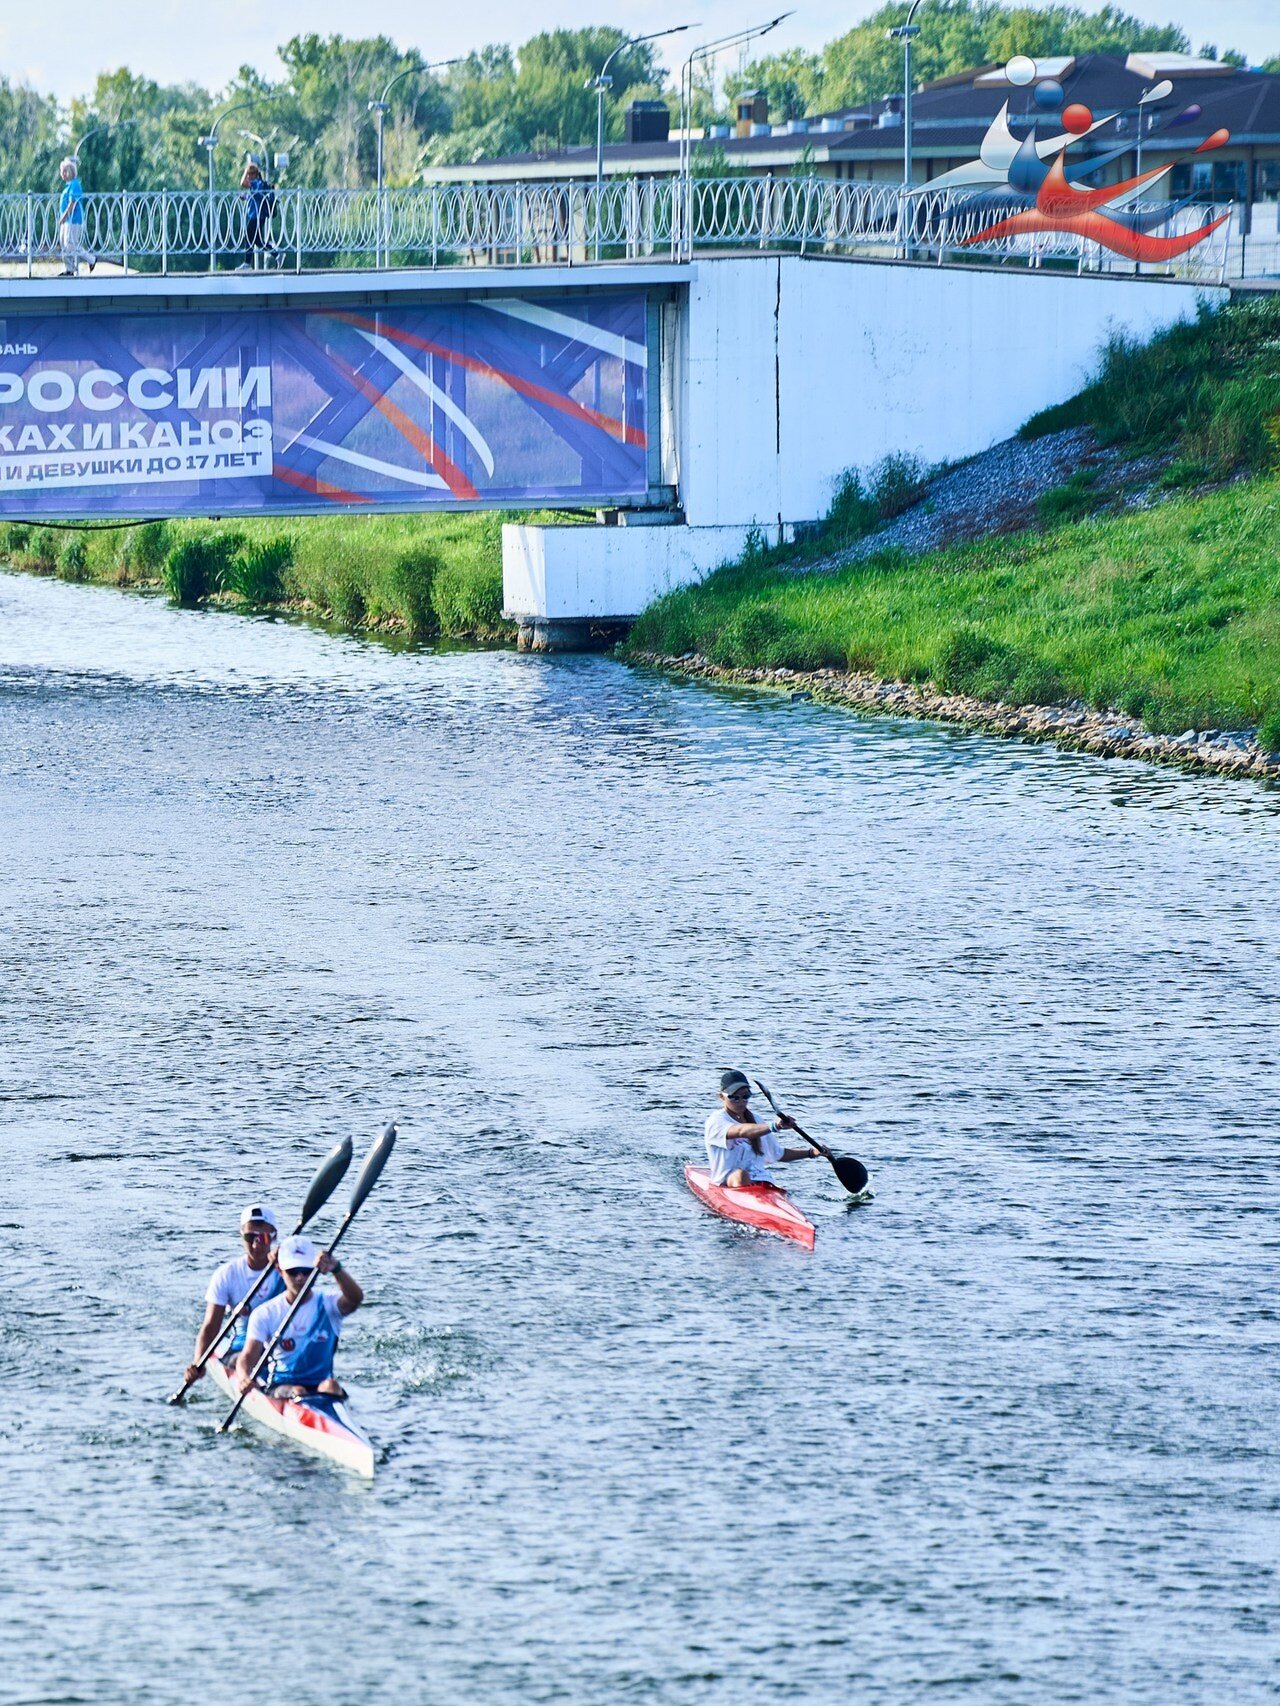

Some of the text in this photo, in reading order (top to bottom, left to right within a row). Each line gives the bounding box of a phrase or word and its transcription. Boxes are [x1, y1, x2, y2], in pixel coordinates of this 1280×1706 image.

[82, 423, 112, 450] И
[119, 419, 273, 449] КАНОЭ
[6, 465, 22, 480] И
[26, 459, 143, 481] ДЕВУШКИ
[146, 456, 181, 475] ДО
[186, 455, 209, 470] 17
[213, 451, 263, 468] ЛЕТ
